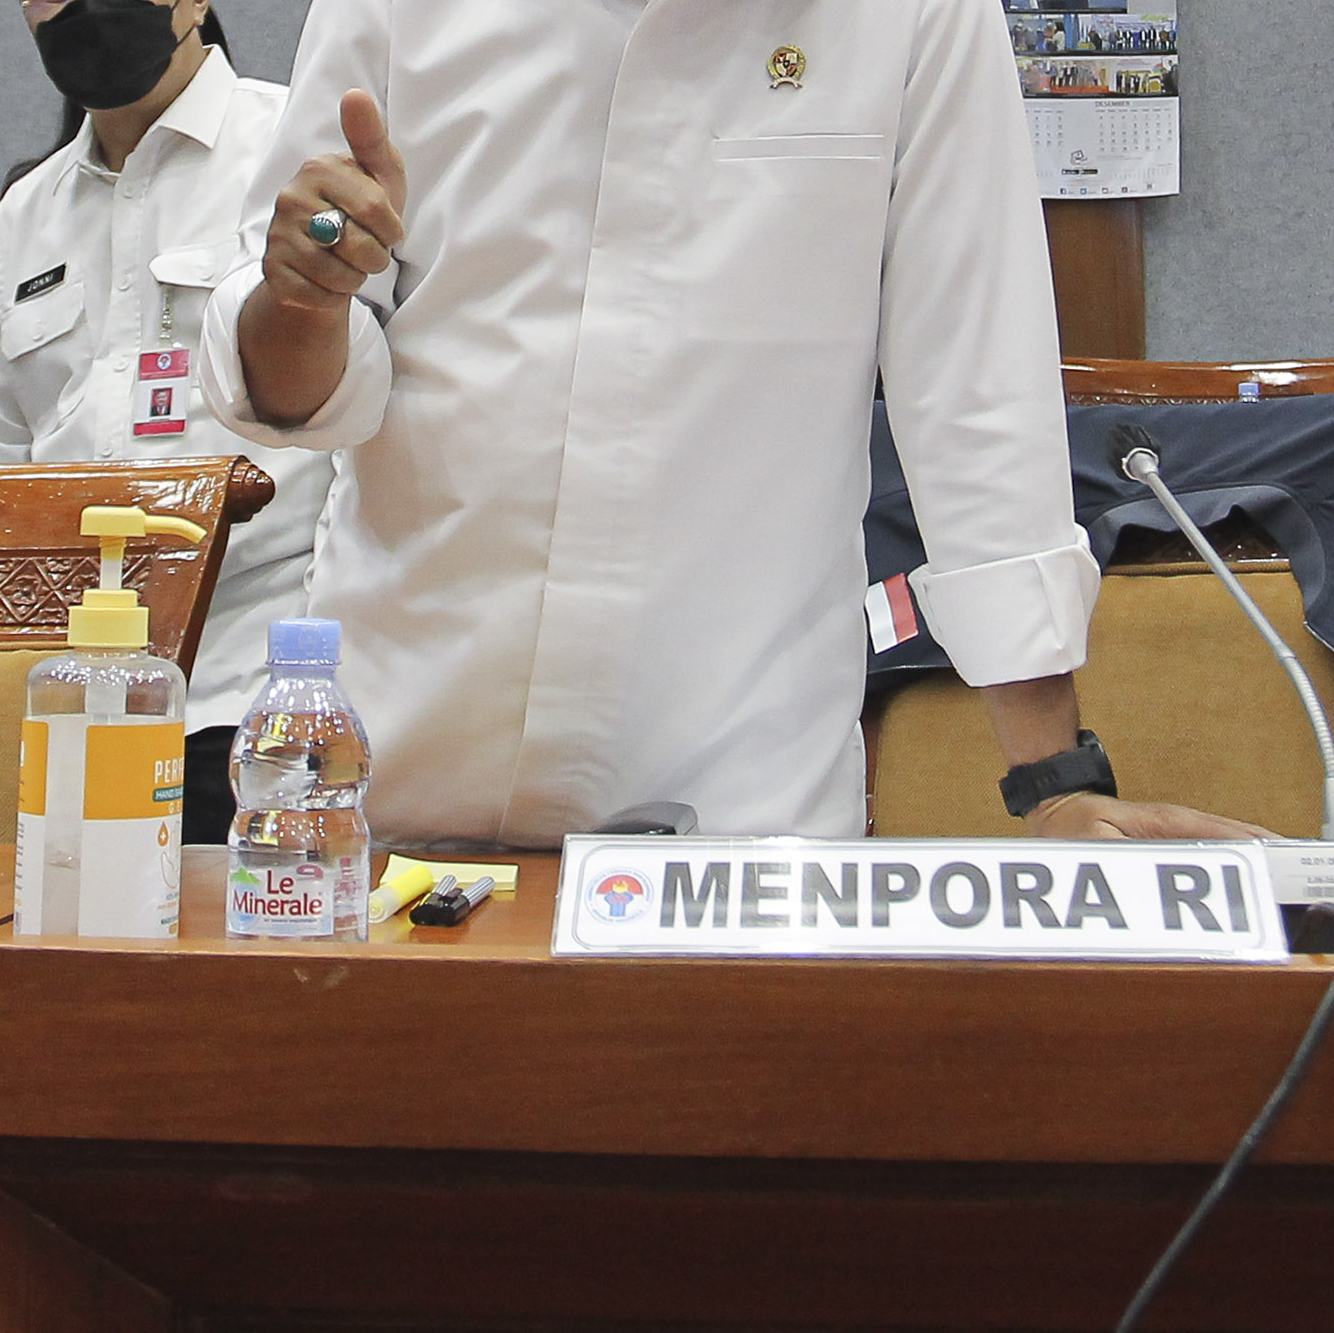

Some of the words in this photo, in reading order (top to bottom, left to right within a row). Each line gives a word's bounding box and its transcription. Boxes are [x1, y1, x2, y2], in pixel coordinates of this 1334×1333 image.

[267, 870, 295, 895] Le
[233, 890, 323, 916] Minerale
[658, 861, 1129, 930] MENPORA
[1157, 862, 1249, 933] RI
